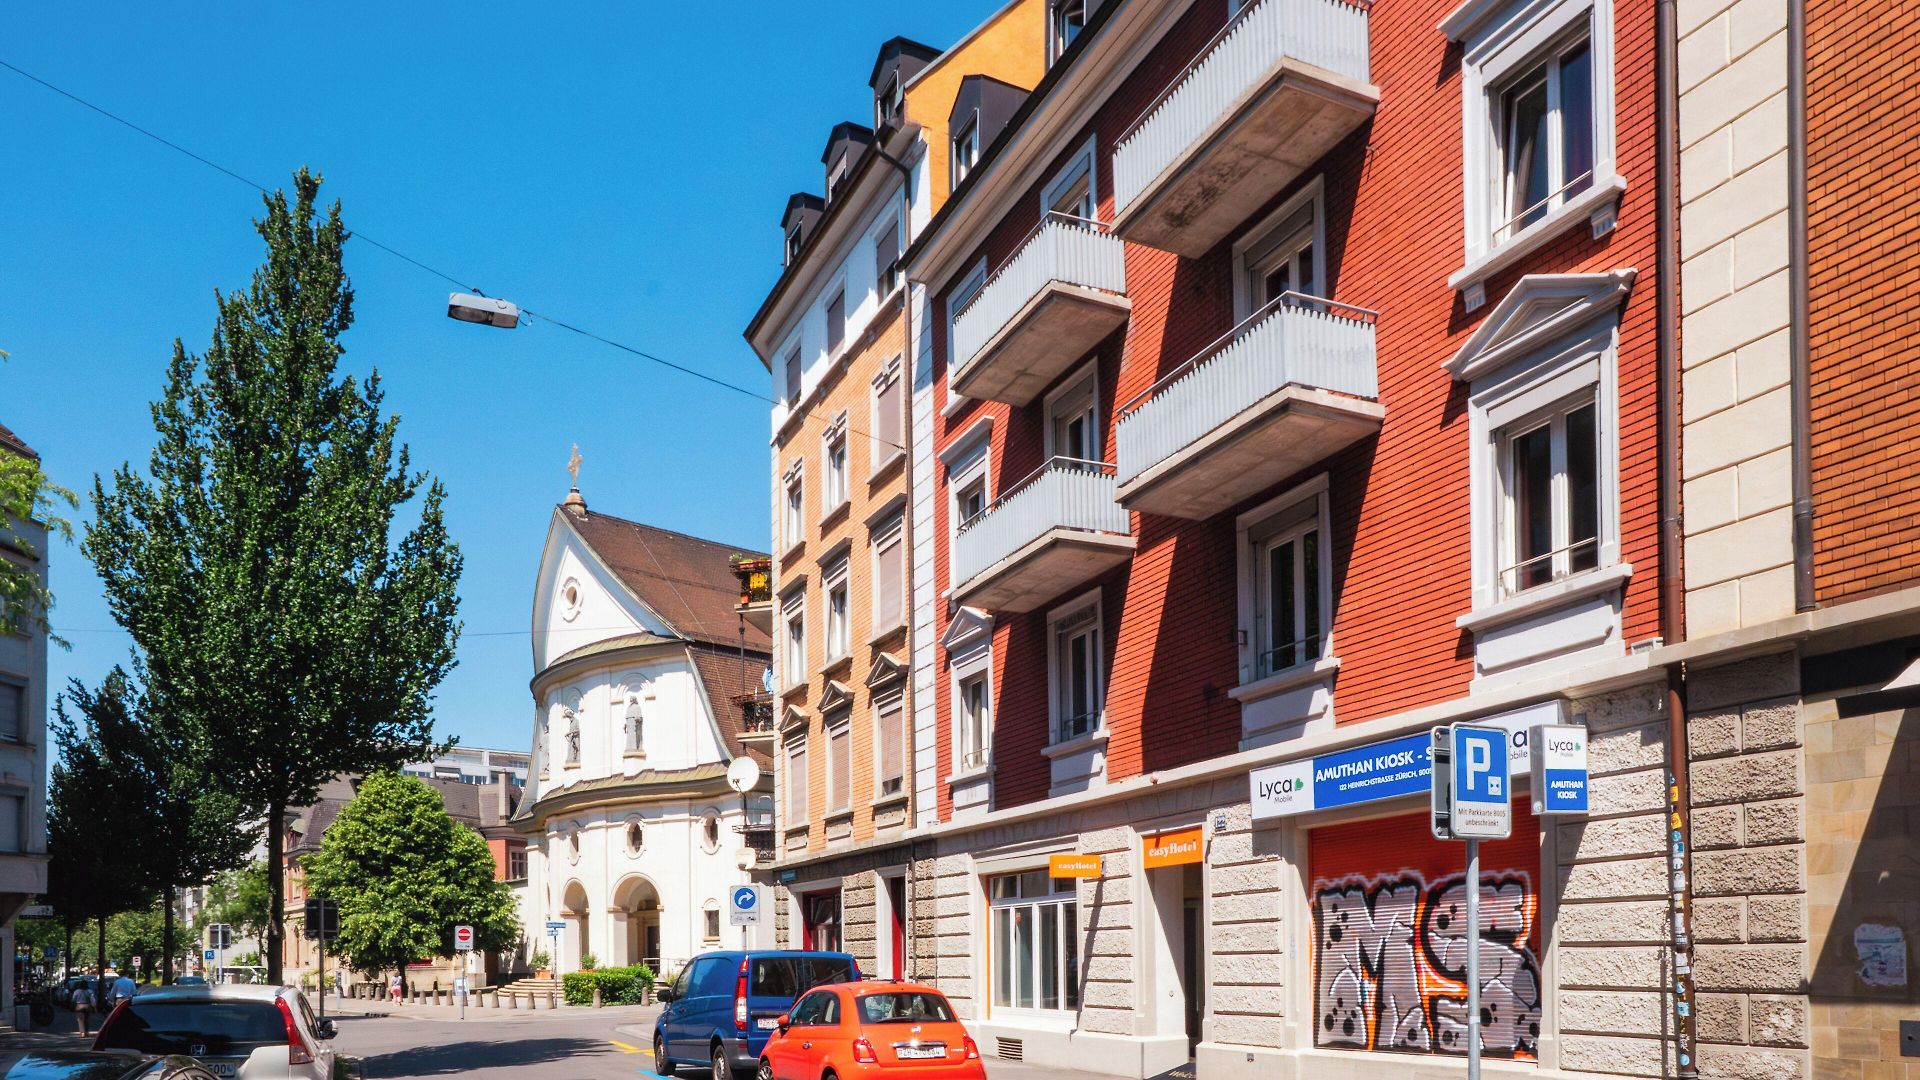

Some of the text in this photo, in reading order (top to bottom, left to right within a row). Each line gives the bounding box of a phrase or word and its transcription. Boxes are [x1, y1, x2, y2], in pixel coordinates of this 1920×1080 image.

[1549, 739, 1573, 753] Lyca
[1509, 749, 1528, 760] obile
[1316, 759, 1373, 782] AMUTHAN
[1375, 750, 1415, 771] KIOSK
[1466, 738, 1490, 790] P
[1260, 779, 1292, 800] Lyca
[1347, 775, 1395, 790] HEINRICHSTRASSE
[1550, 780, 1583, 788] AMUTHAN
[1149, 841, 1197, 857] easyHotel
[1058, 861, 1097, 871] easyHotel
